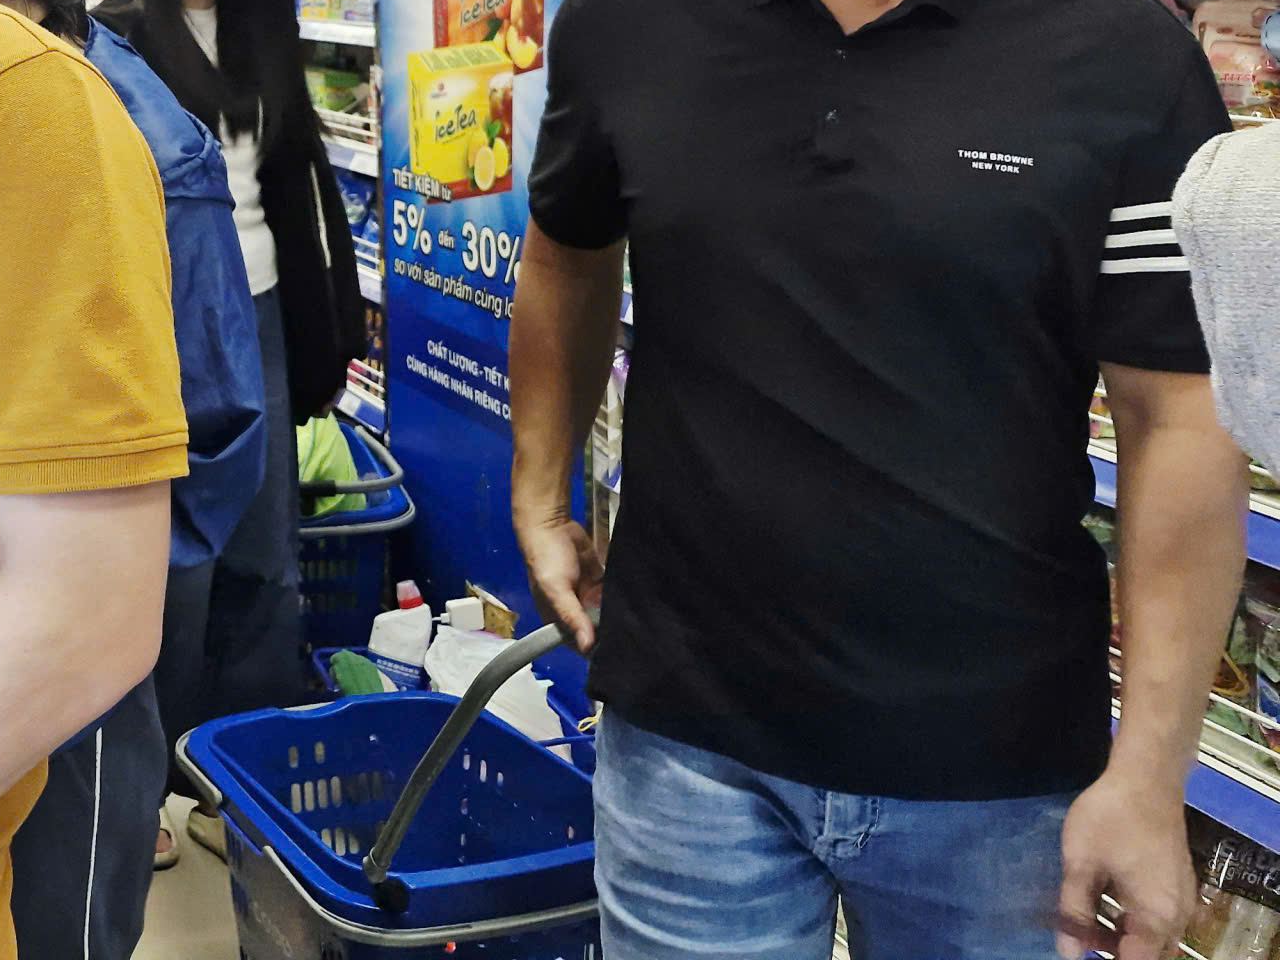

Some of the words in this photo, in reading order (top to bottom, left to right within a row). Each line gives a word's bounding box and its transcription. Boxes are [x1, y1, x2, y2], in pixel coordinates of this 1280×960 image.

[957, 149, 988, 160] THOM
[989, 152, 1034, 167] BROWNE
[971, 161, 993, 171] NEW
[994, 163, 1020, 174] YORK
[392, 199, 432, 255] 5%
[394, 257, 406, 275] so
[407, 261, 422, 281] với
[423, 266, 441, 289] sản
[474, 287, 503, 319] cùng
